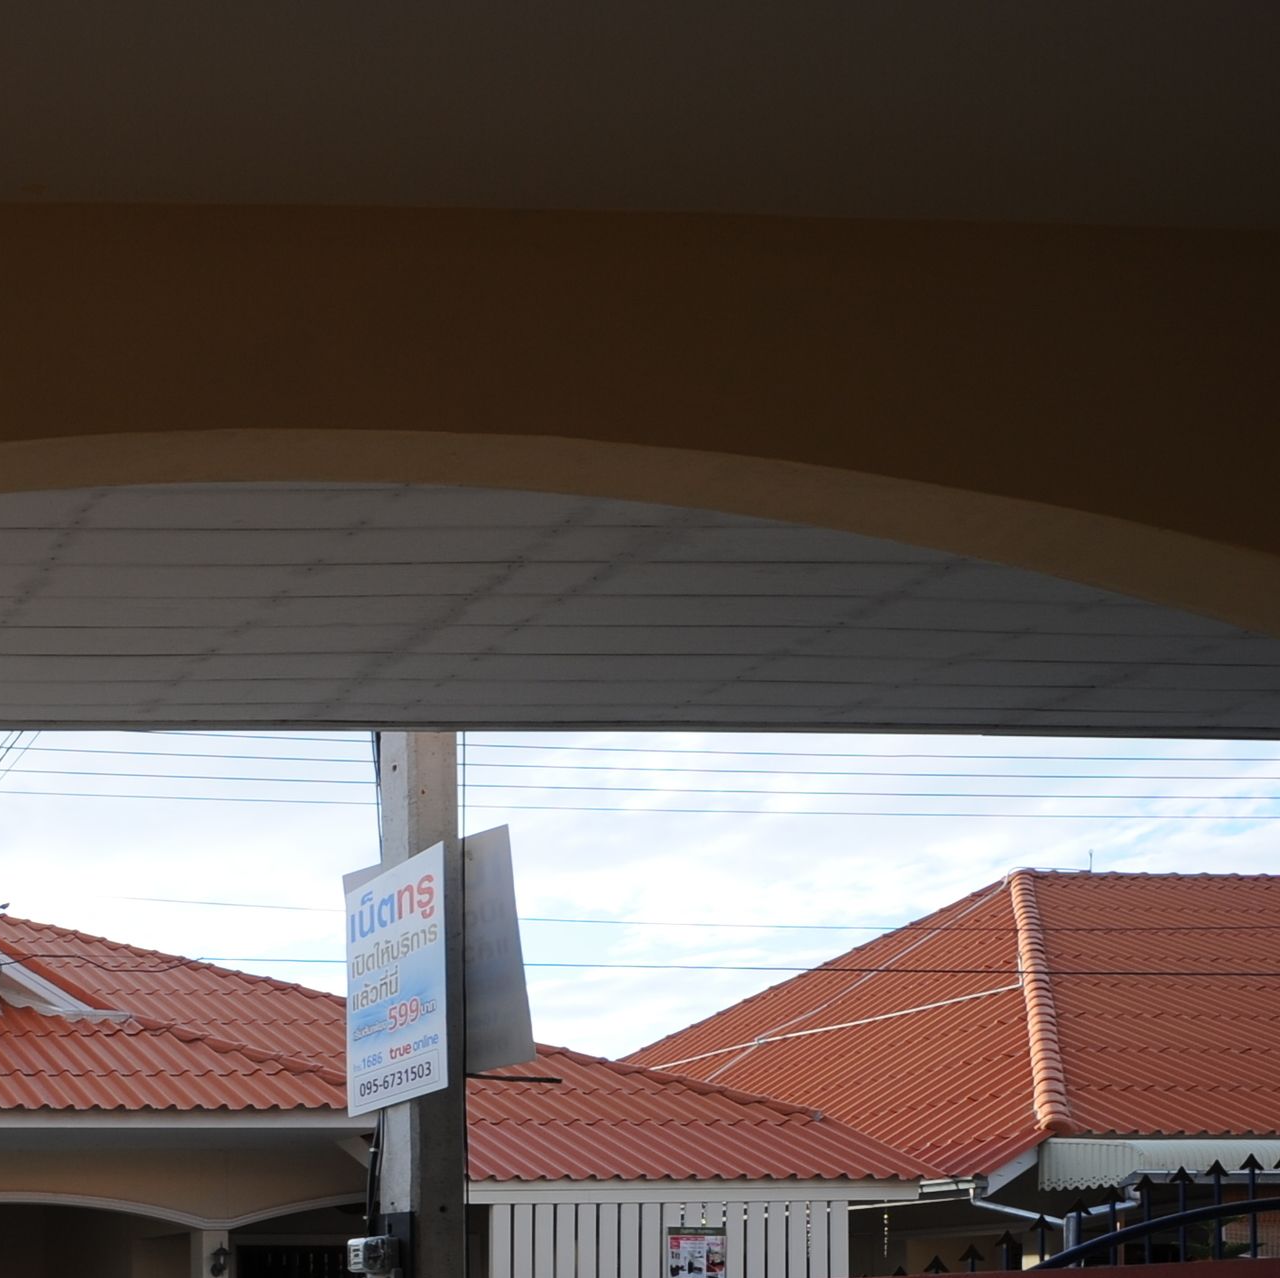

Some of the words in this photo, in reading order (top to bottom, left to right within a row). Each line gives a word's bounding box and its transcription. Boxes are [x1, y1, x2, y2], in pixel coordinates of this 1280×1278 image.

[351, 923, 437, 979] เปิดให้บริการ
[352, 965, 399, 1012] แล้วที่นี่
[388, 998, 419, 1031] 599
[389, 1043, 412, 1060] true
[359, 1061, 432, 1097] 095-6731503
